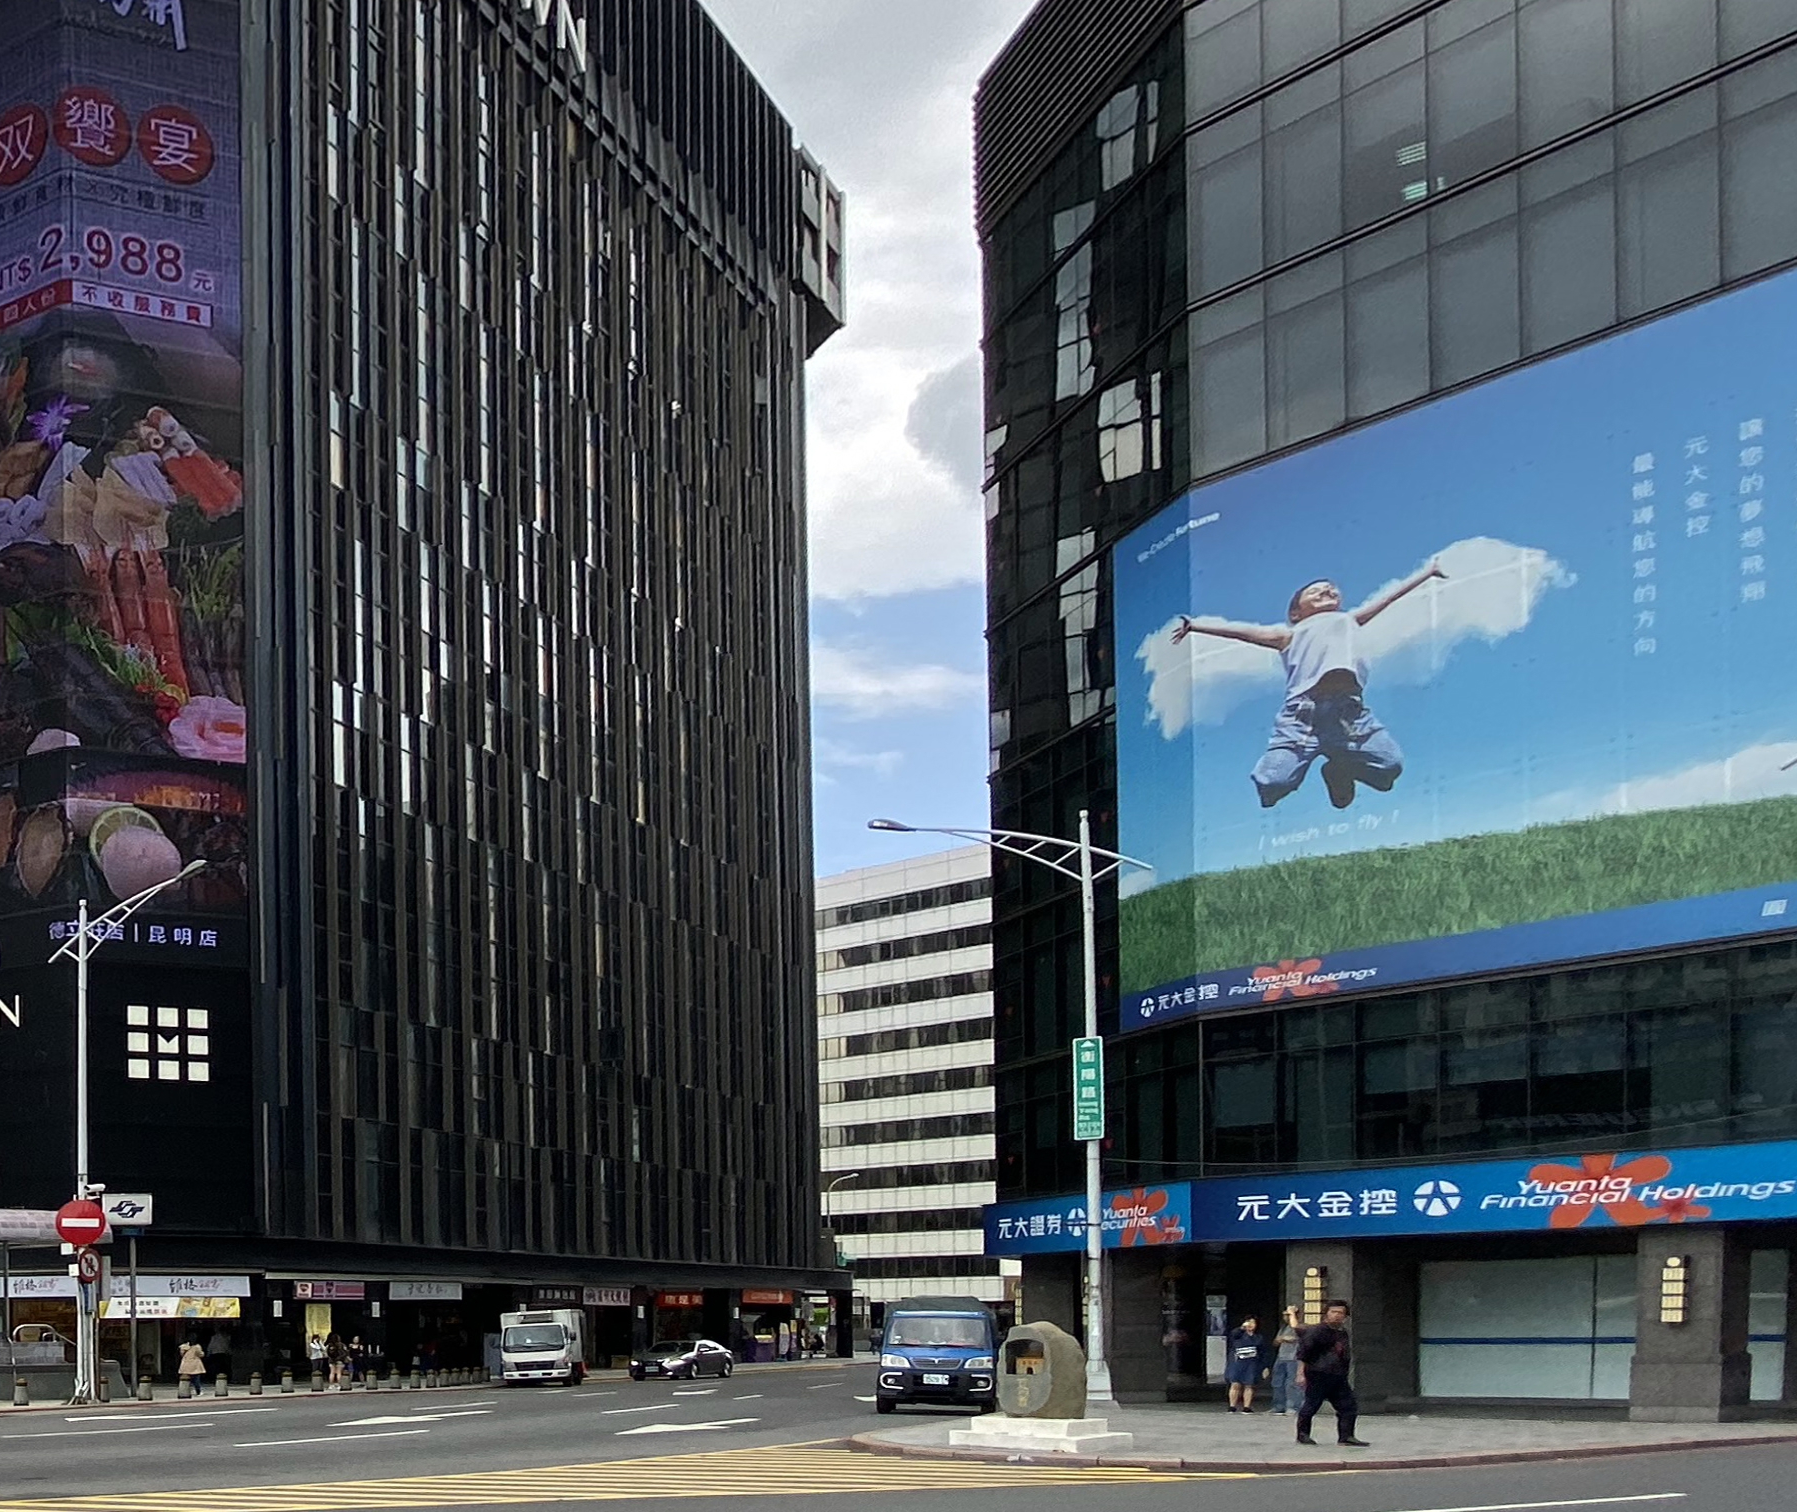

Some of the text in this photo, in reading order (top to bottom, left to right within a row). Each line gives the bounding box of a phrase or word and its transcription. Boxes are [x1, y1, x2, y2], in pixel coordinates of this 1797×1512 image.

[40, 226, 183, 284] 2,988
[193, 273, 213, 292] 元
[82, 284, 202, 324] 不收服務費
[1684, 435, 1711, 538] 元大金控
[1327, 822, 1350, 837] to
[147, 925, 217, 948] 昆明店
[1227, 967, 1378, 996] Financial Holdings
[1245, 970, 1304, 987] Yuanta
[1157, 983, 1220, 1013] 元大金控
[1479, 1179, 1797, 1210] Financial Holdings
[1516, 1174, 1634, 1196] Yuanta
[1102, 1203, 1148, 1221] Yuanta
[1236, 1188, 1398, 1222] 元大金控
[1101, 1214, 1157, 1231] ecurities
